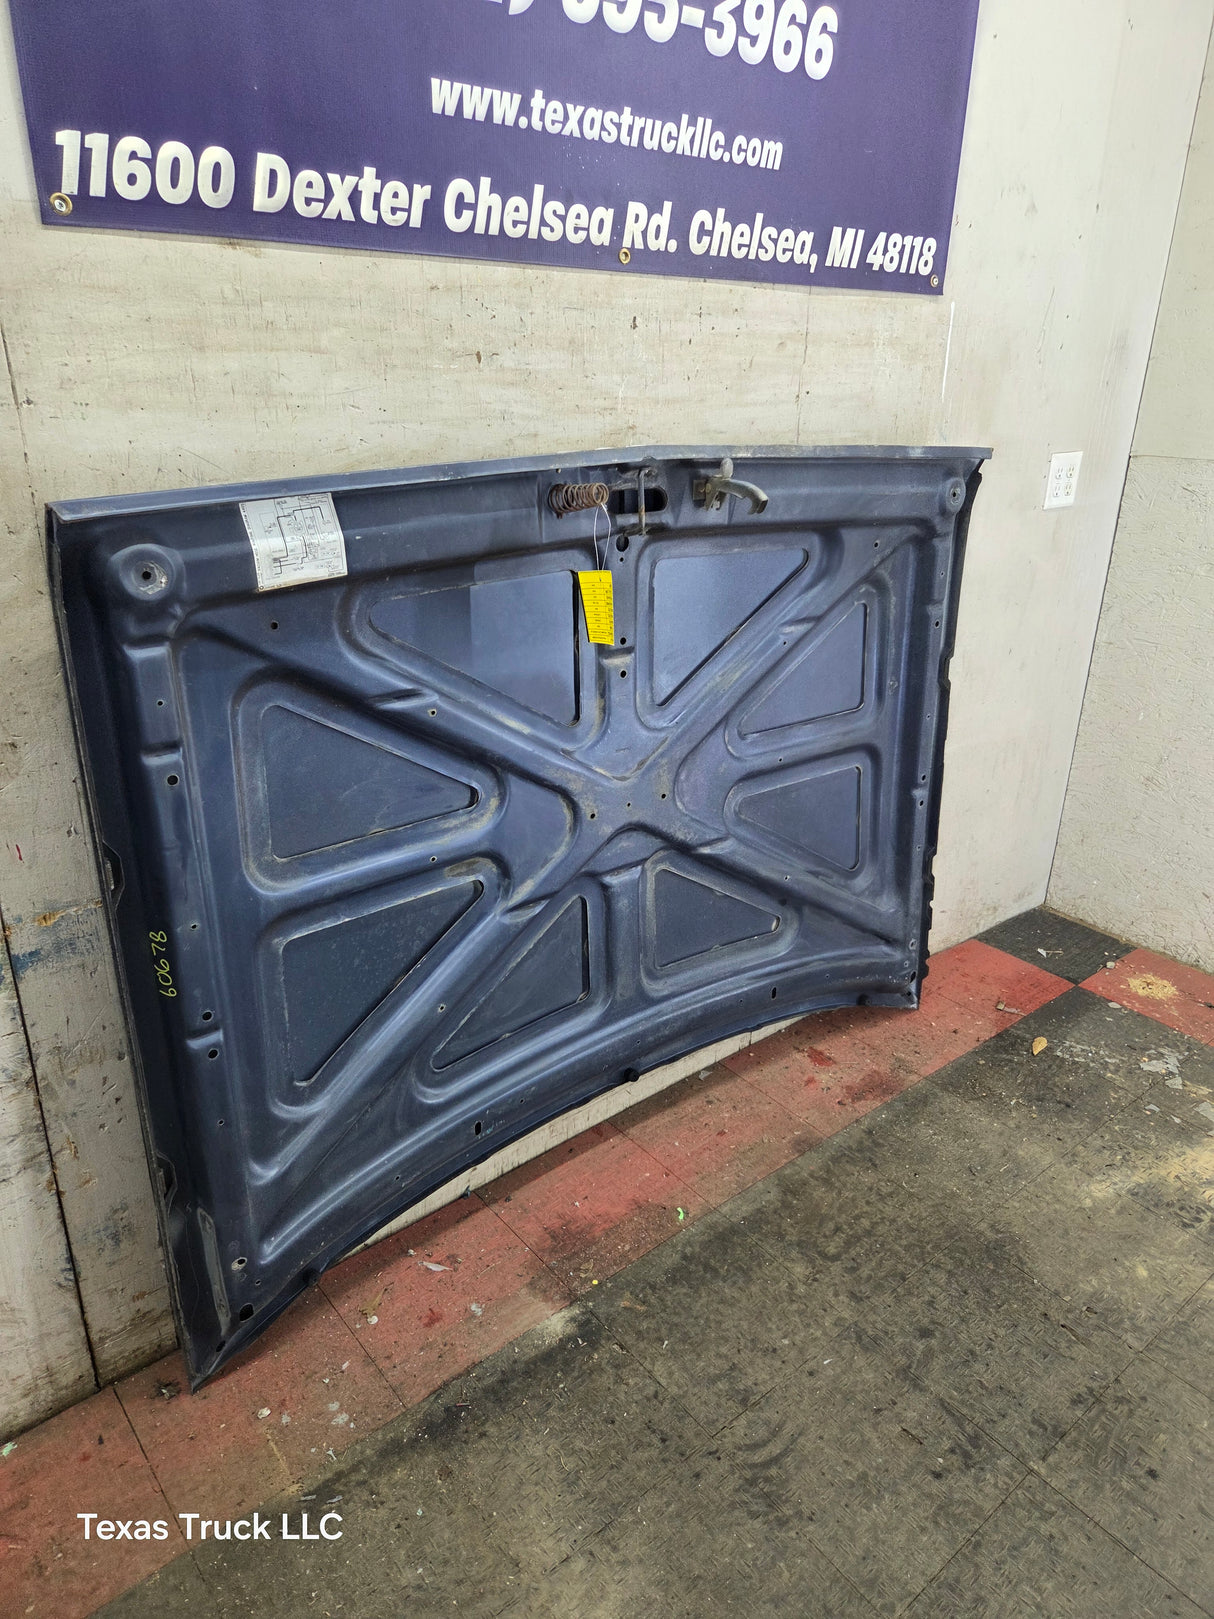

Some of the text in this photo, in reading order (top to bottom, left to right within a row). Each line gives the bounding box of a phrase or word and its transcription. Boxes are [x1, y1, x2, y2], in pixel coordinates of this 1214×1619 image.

[430, 77, 784, 171] www.texastruckllc.com
[55, 129, 937, 277] 11600 Dexter Chelsea Rd. Chelsea, MI 48118
